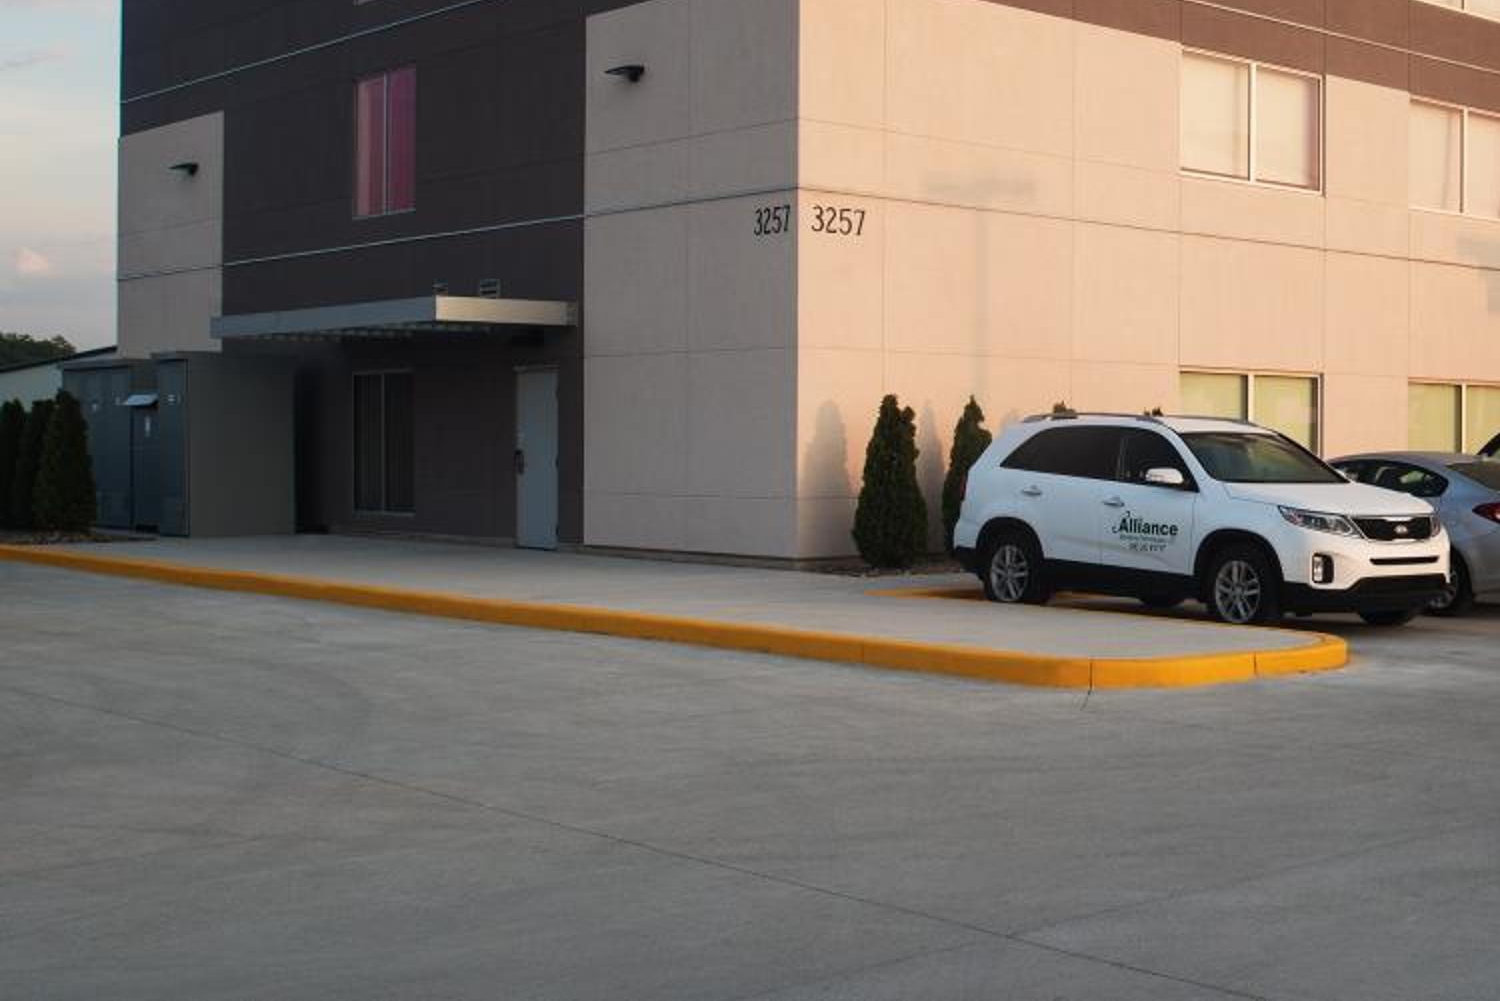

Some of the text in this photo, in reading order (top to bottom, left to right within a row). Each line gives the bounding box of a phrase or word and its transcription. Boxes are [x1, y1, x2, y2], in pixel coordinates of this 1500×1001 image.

[754, 204, 791, 236] 3257
[811, 205, 866, 236] 3257
[1119, 517, 1179, 536] Alliance
